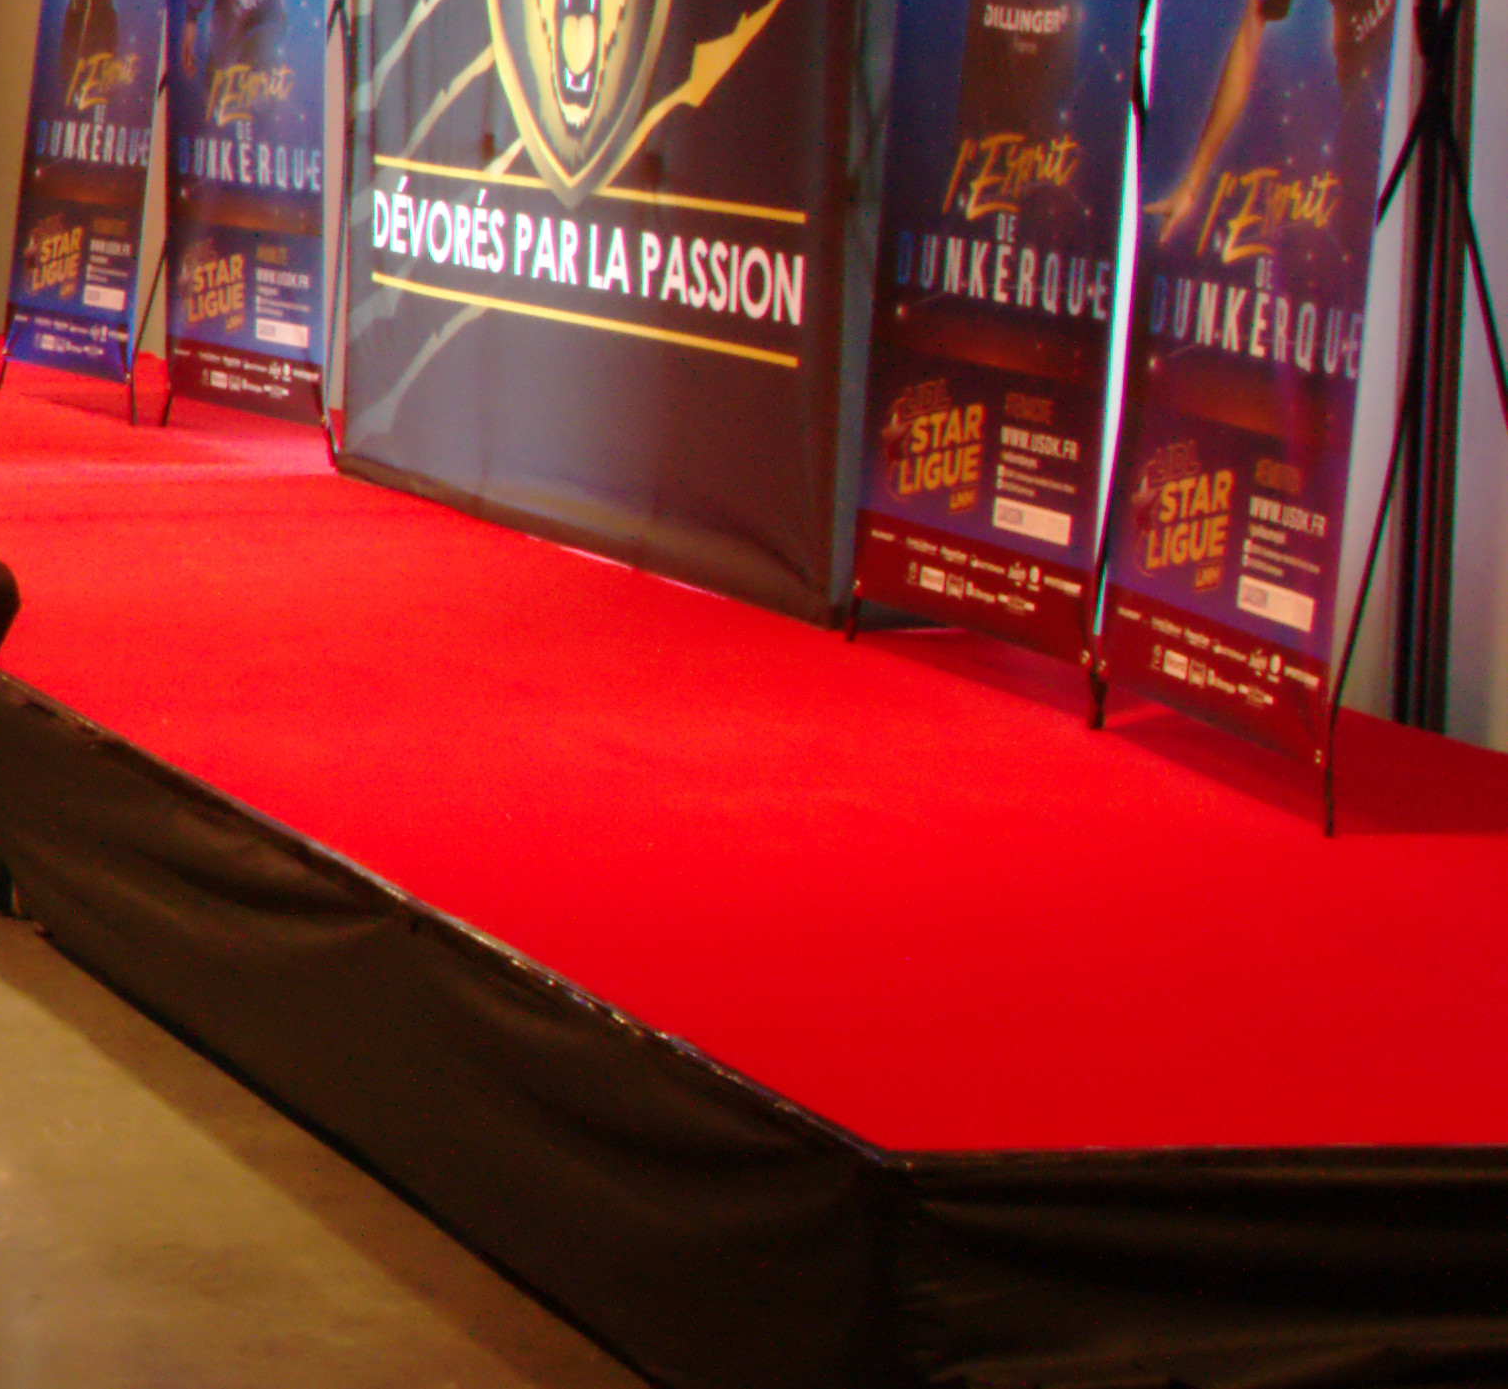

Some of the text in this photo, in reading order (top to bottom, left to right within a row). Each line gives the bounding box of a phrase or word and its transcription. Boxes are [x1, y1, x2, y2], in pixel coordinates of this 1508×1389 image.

[36, 120, 151, 166] DUNKERQUE
[179, 136, 321, 191] DUNKERQUE
[40, 225, 83, 263] STAR
[373, 175, 804, 326] DÉVORÉS PAR LA PASSION
[996, 213, 1017, 243] DE
[193, 253, 245, 293] STAR
[896, 230, 1111, 320] DUNKERQUE
[188, 282, 245, 323] LIGUE
[1150, 274, 1364, 379] DUNKERQUE
[911, 403, 986, 454] STAR
[898, 444, 982, 495] LIGUE
[1159, 470, 1234, 523] STAR
[1146, 514, 1230, 569] LIGUE
